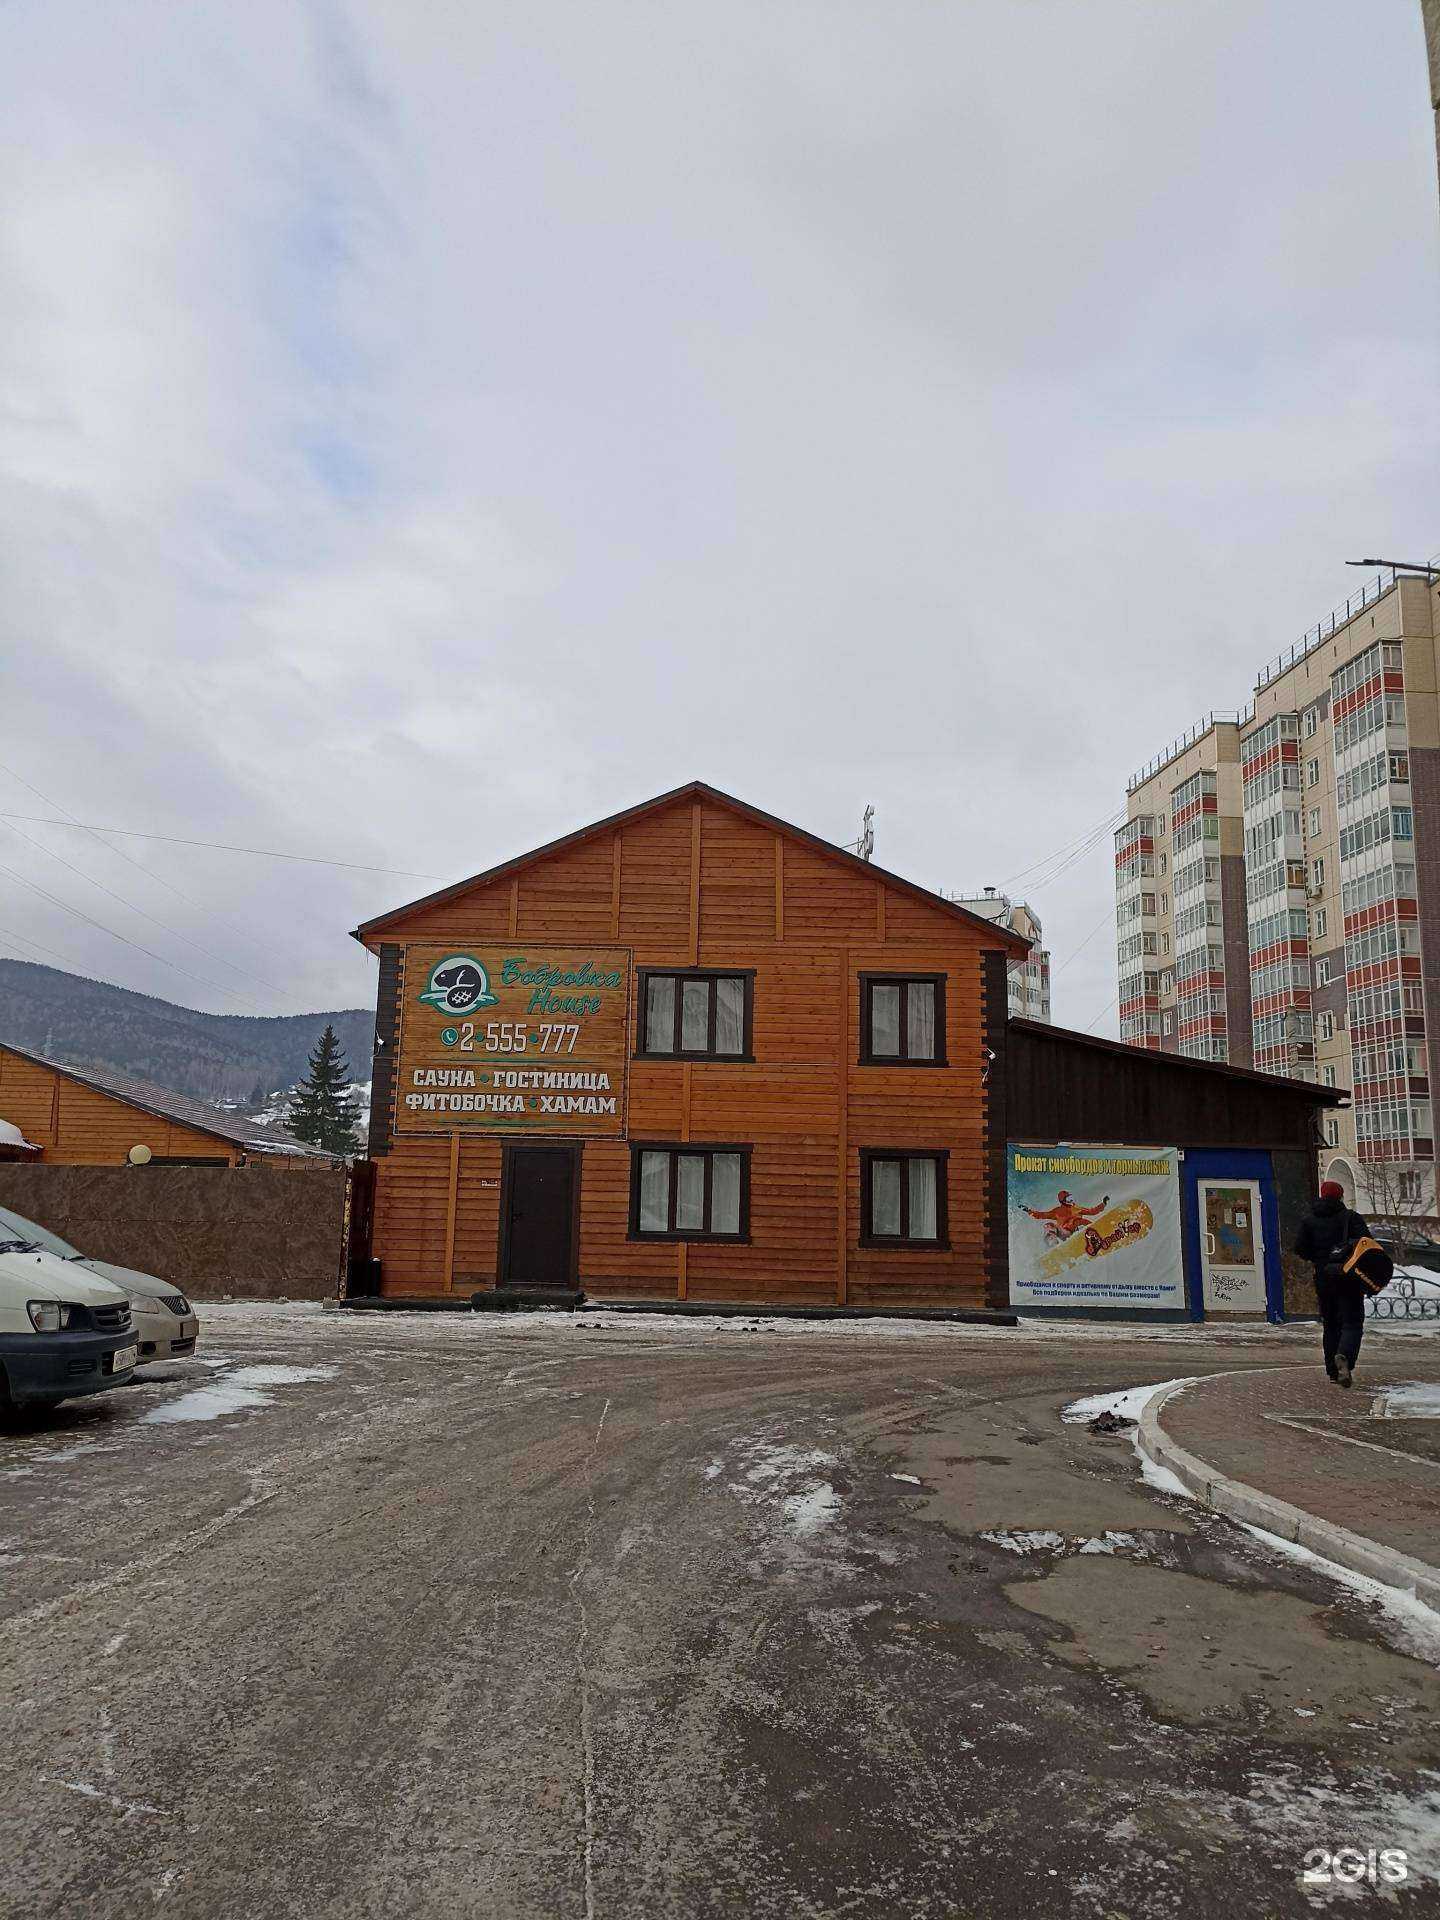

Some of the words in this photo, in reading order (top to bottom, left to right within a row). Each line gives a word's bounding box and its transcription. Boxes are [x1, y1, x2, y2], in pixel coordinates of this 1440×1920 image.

[502, 958, 621, 987] Бобровка
[527, 986, 602, 1015] House
[460, 1022, 475, 1051] 2
[485, 1023, 527, 1052] 555
[540, 1024, 579, 1053] 777
[413, 1069, 476, 1087] САУНА
[493, 1071, 610, 1091] ГОСТИНИЦА
[405, 1094, 526, 1112] ФИТОБОЧКА
[540, 1095, 616, 1114] ХАМАМ
[1014, 1153, 1046, 1172] Прокат
